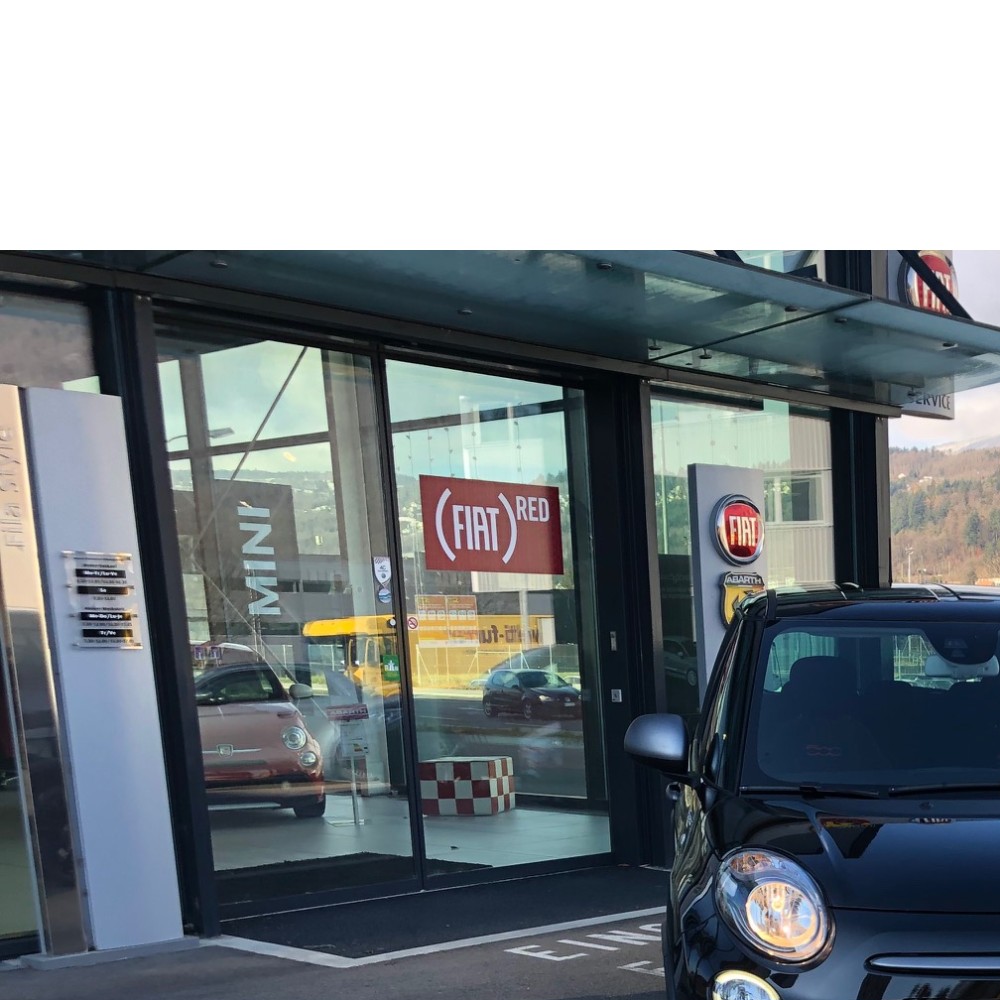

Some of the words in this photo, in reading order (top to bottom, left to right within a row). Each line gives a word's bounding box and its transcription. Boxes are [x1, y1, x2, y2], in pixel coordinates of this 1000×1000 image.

[515, 495, 550, 522] RED
[728, 515, 757, 547] FIAT
[237, 506, 281, 614] MINI
[726, 575, 762, 585] ABARTH
